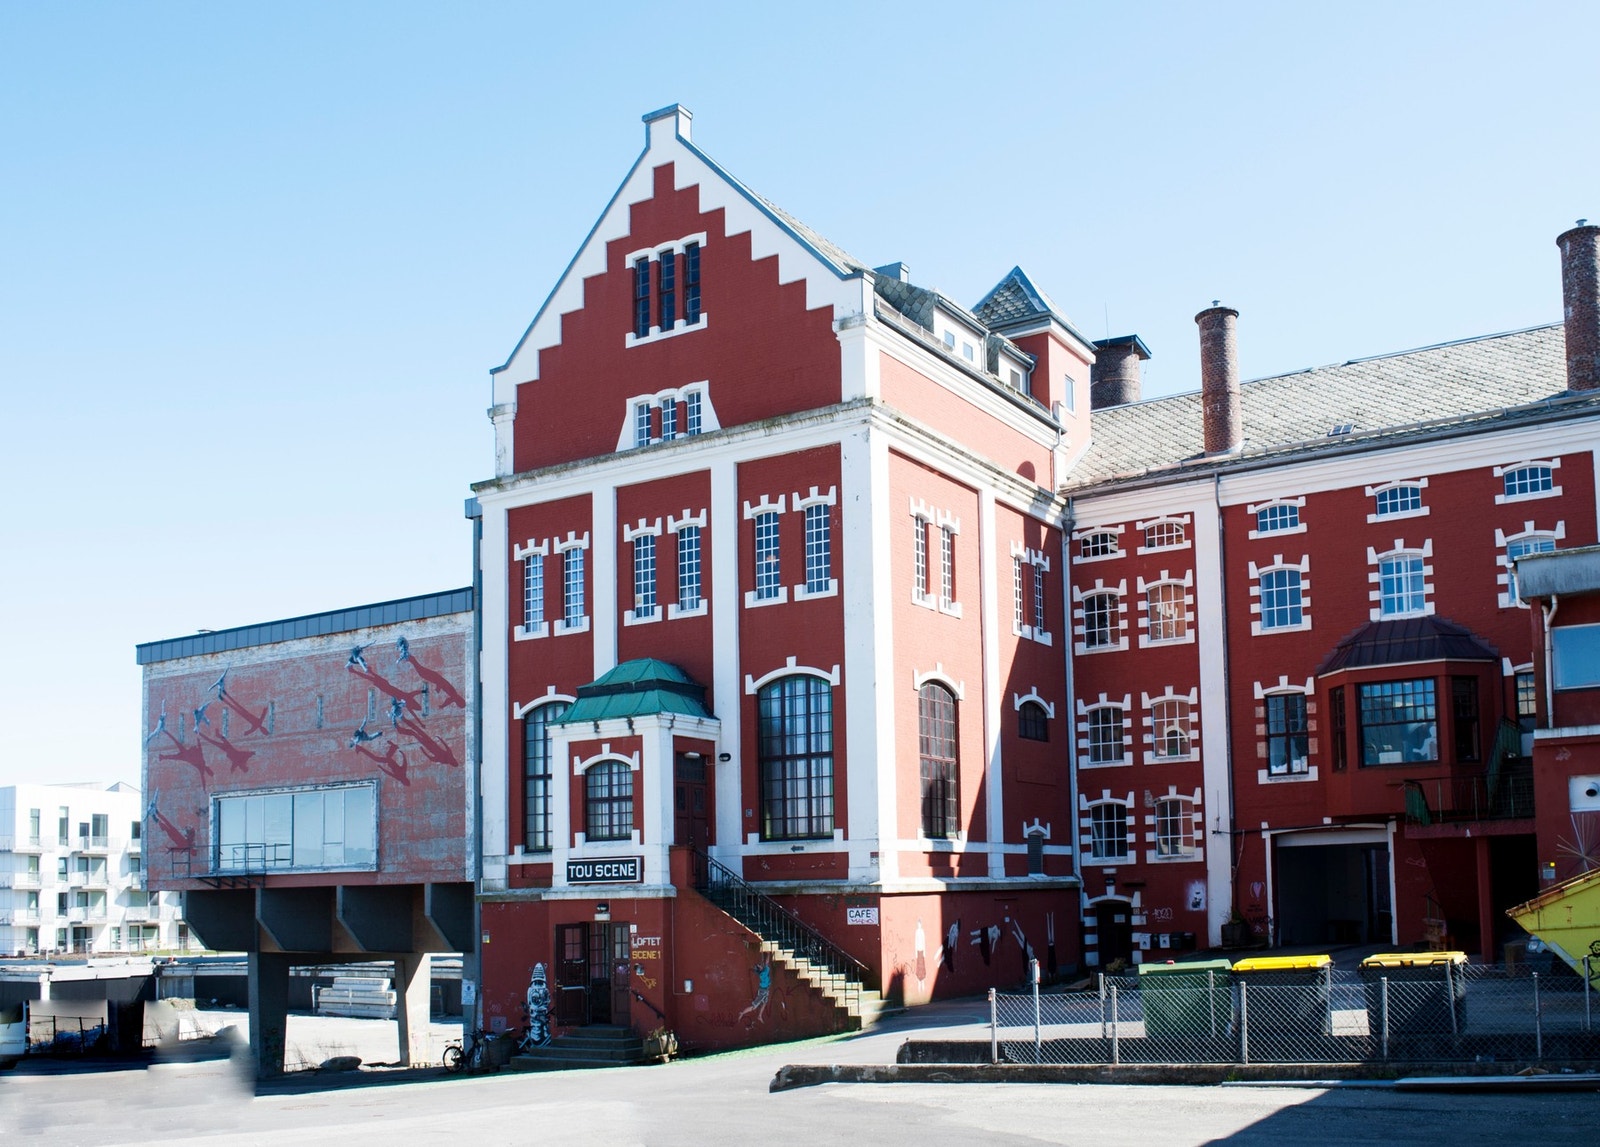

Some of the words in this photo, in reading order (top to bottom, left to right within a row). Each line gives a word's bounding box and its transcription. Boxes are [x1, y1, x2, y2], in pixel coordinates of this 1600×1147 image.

[568, 865, 592, 878] TOU
[595, 863, 635, 877] SCENE
[632, 937, 661, 946] LOFTET
[632, 950, 656, 959] SCENE
